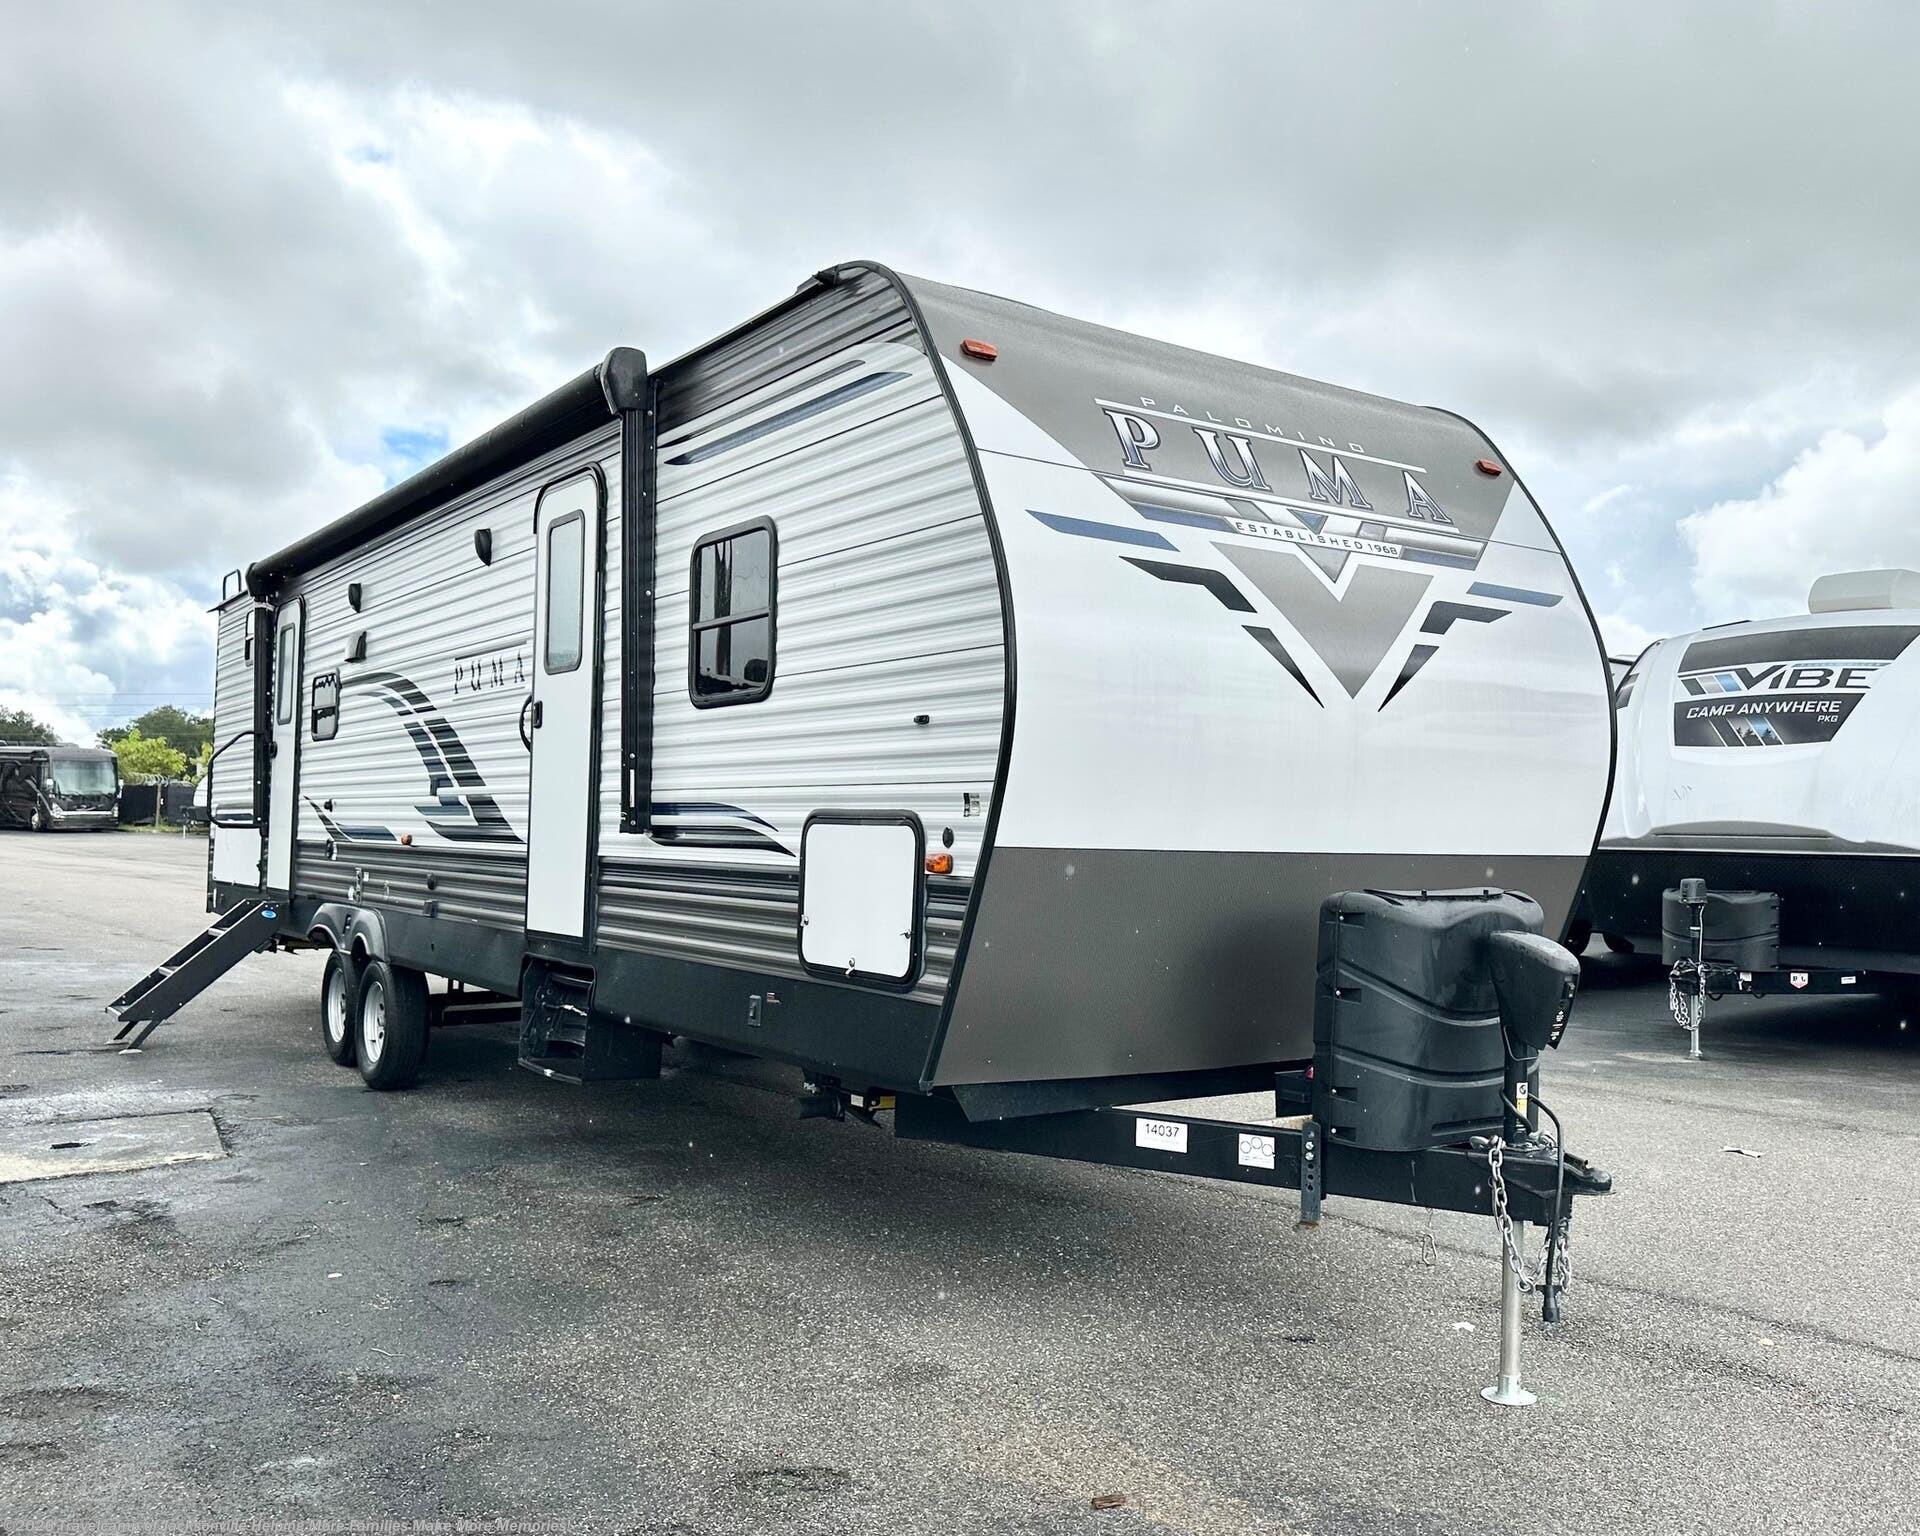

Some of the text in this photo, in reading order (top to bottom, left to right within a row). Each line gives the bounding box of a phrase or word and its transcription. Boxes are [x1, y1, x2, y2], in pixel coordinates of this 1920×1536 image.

[1140, 396, 1366, 454] PALOMINO
[1103, 408, 1455, 525] PUMA
[1234, 521, 1400, 557] ESTABLISHED 1968
[454, 650, 526, 694] PUMA
[1735, 664, 1880, 690] VIBE
[1686, 700, 1843, 719] CAMP ANYWHERE
[1817, 714, 1839, 723] PKG
[1144, 1123, 1180, 1137] 14037
